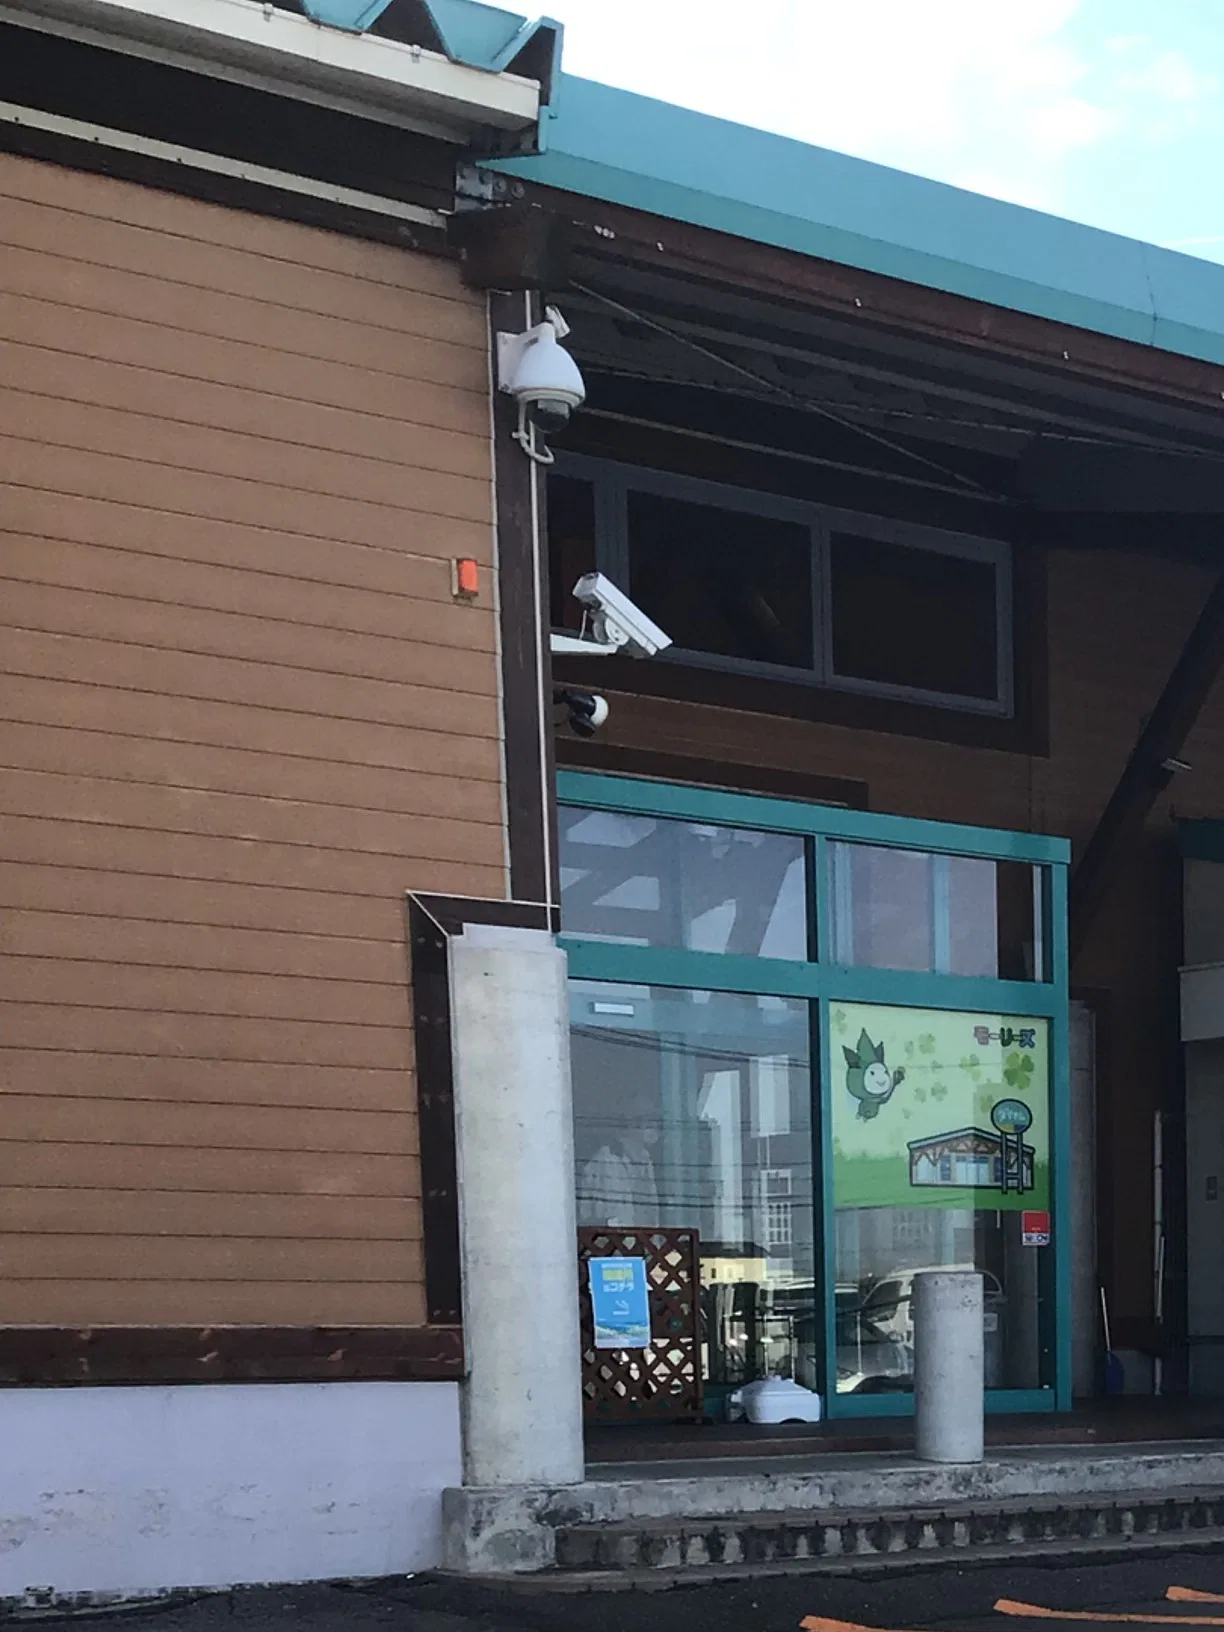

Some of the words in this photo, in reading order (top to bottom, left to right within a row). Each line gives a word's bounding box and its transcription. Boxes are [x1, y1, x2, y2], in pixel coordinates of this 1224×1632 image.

[974, 1025, 1036, 1049] モーリーズ
